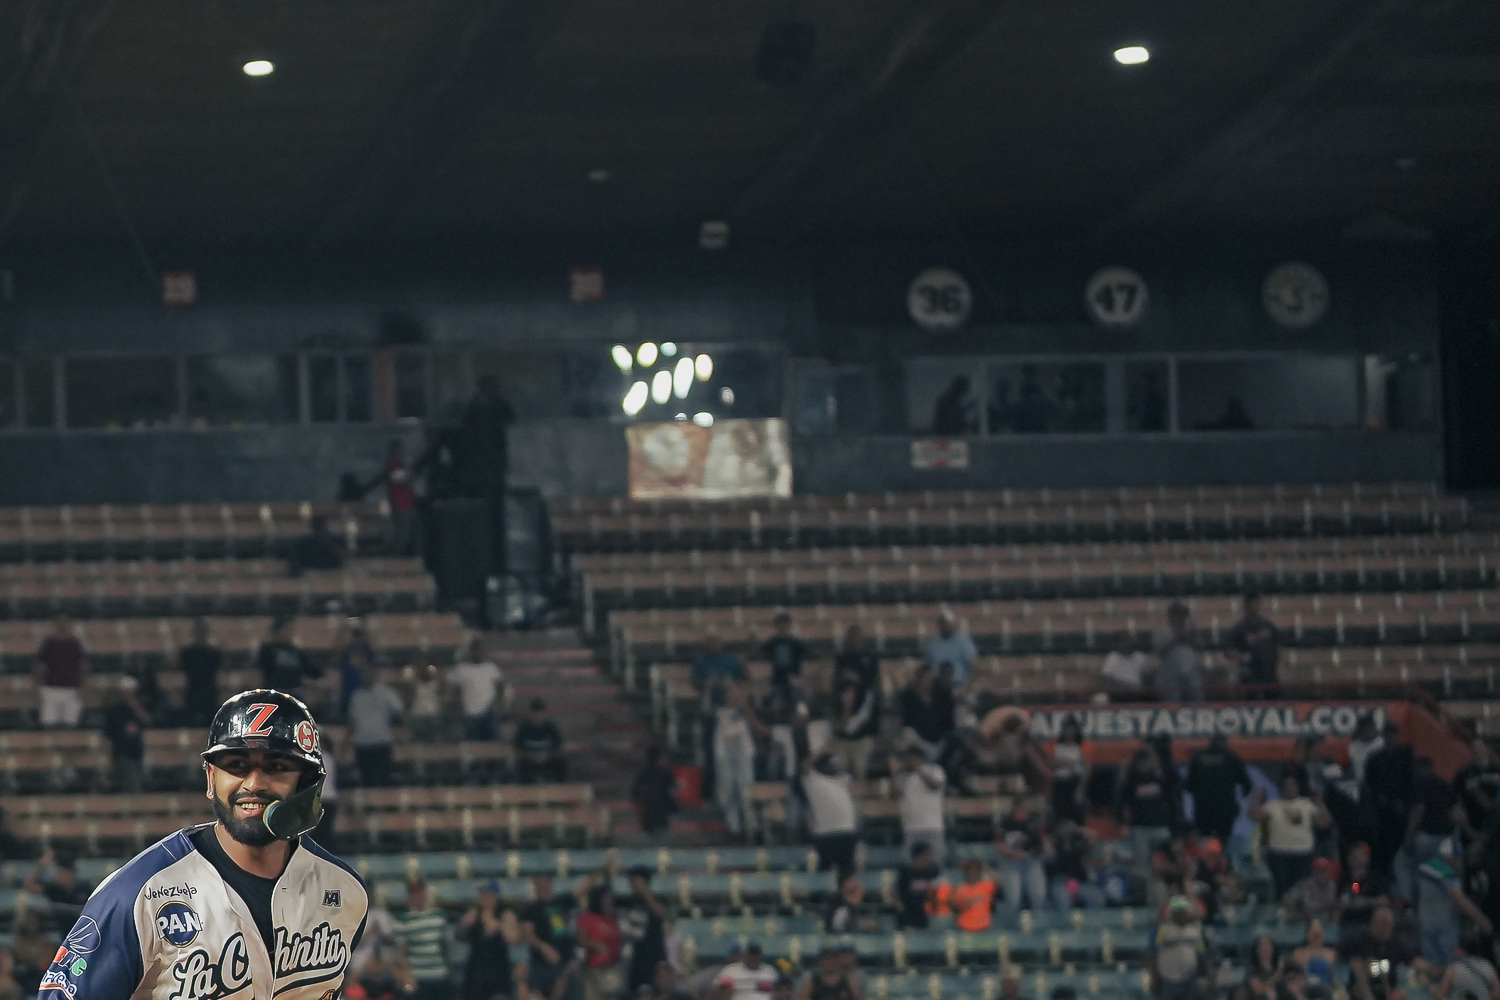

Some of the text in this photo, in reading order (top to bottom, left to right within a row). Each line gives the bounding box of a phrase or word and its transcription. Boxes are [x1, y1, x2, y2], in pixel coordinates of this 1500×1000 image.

[916, 284, 963, 315] 36
[1095, 283, 1138, 314] 47
[241, 703, 278, 738] Z
